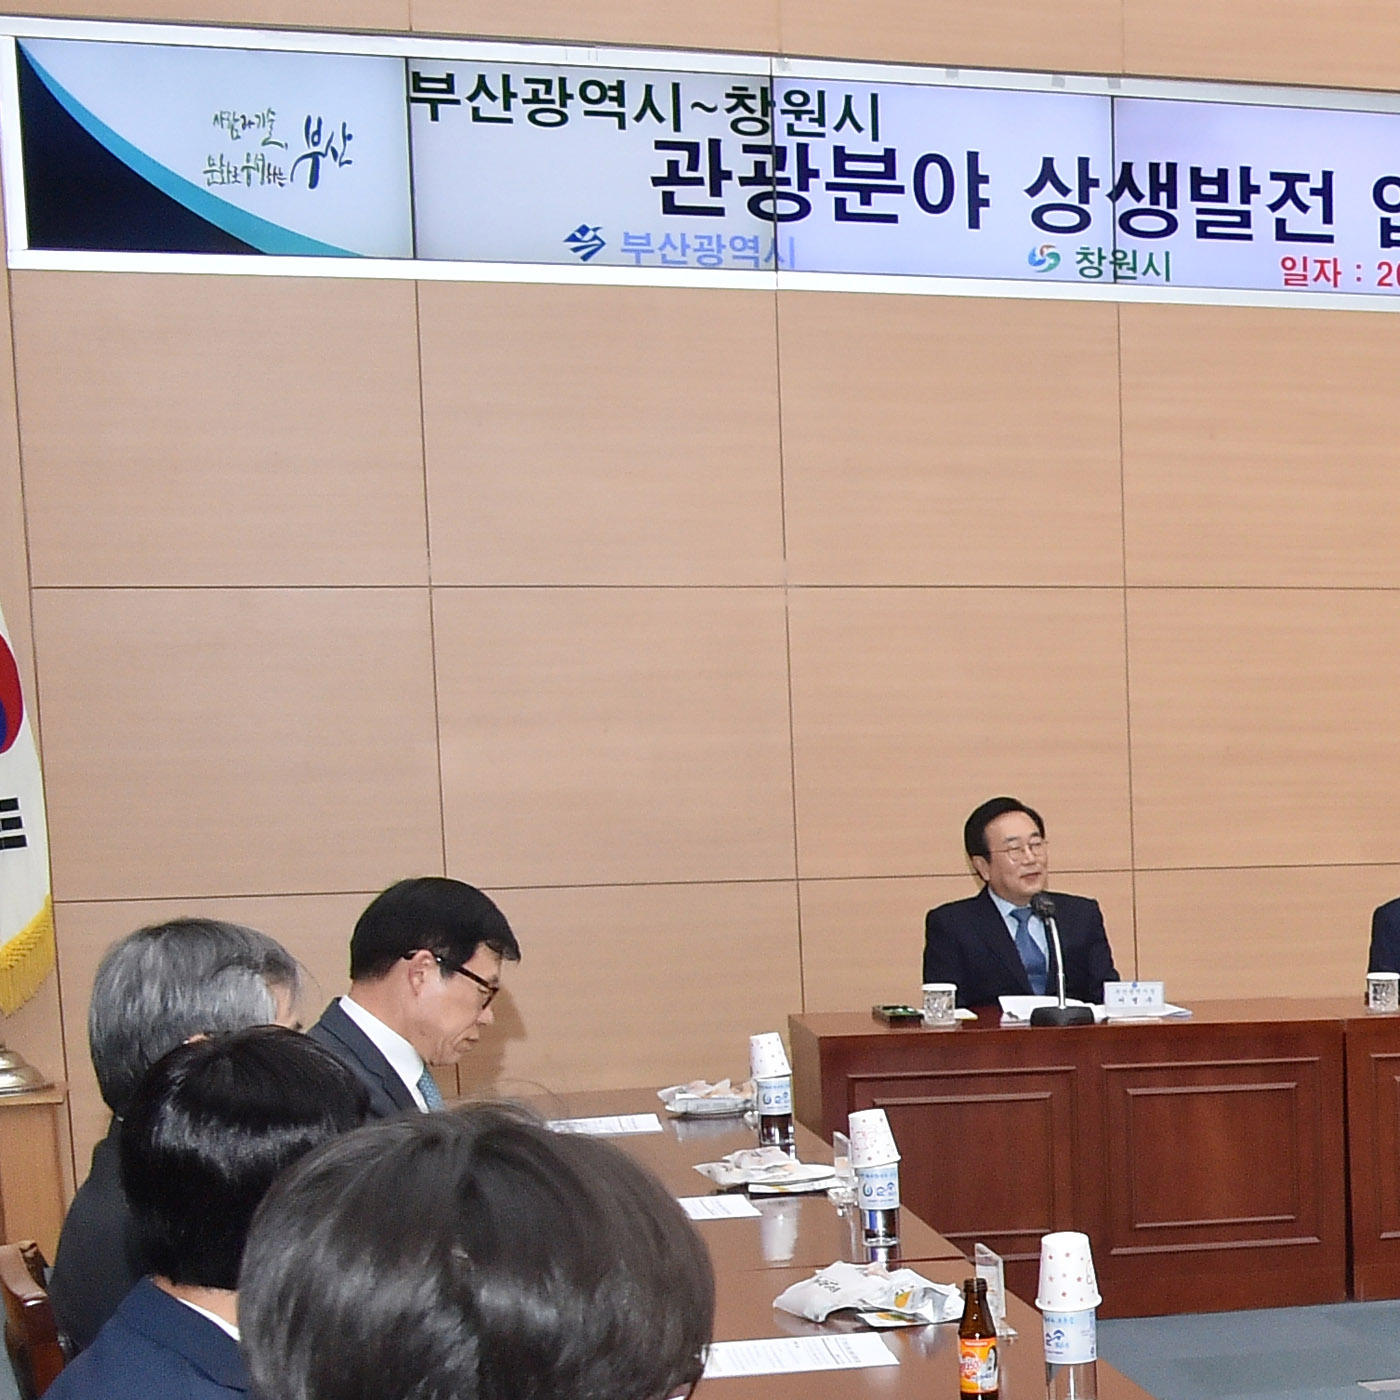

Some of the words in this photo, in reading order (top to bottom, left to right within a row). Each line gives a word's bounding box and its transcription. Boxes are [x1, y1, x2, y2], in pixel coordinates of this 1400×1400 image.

[410, 71, 881, 142] 부산광역시~창원시
[290, 114, 353, 189] 부산
[650, 137, 990, 230] 관광분야
[1024, 156, 1335, 244] 상생발전
[620, 231, 796, 270] 부산광역시
[1075, 244, 1172, 284] 창원시
[1281, 256, 1342, 287] 일자
